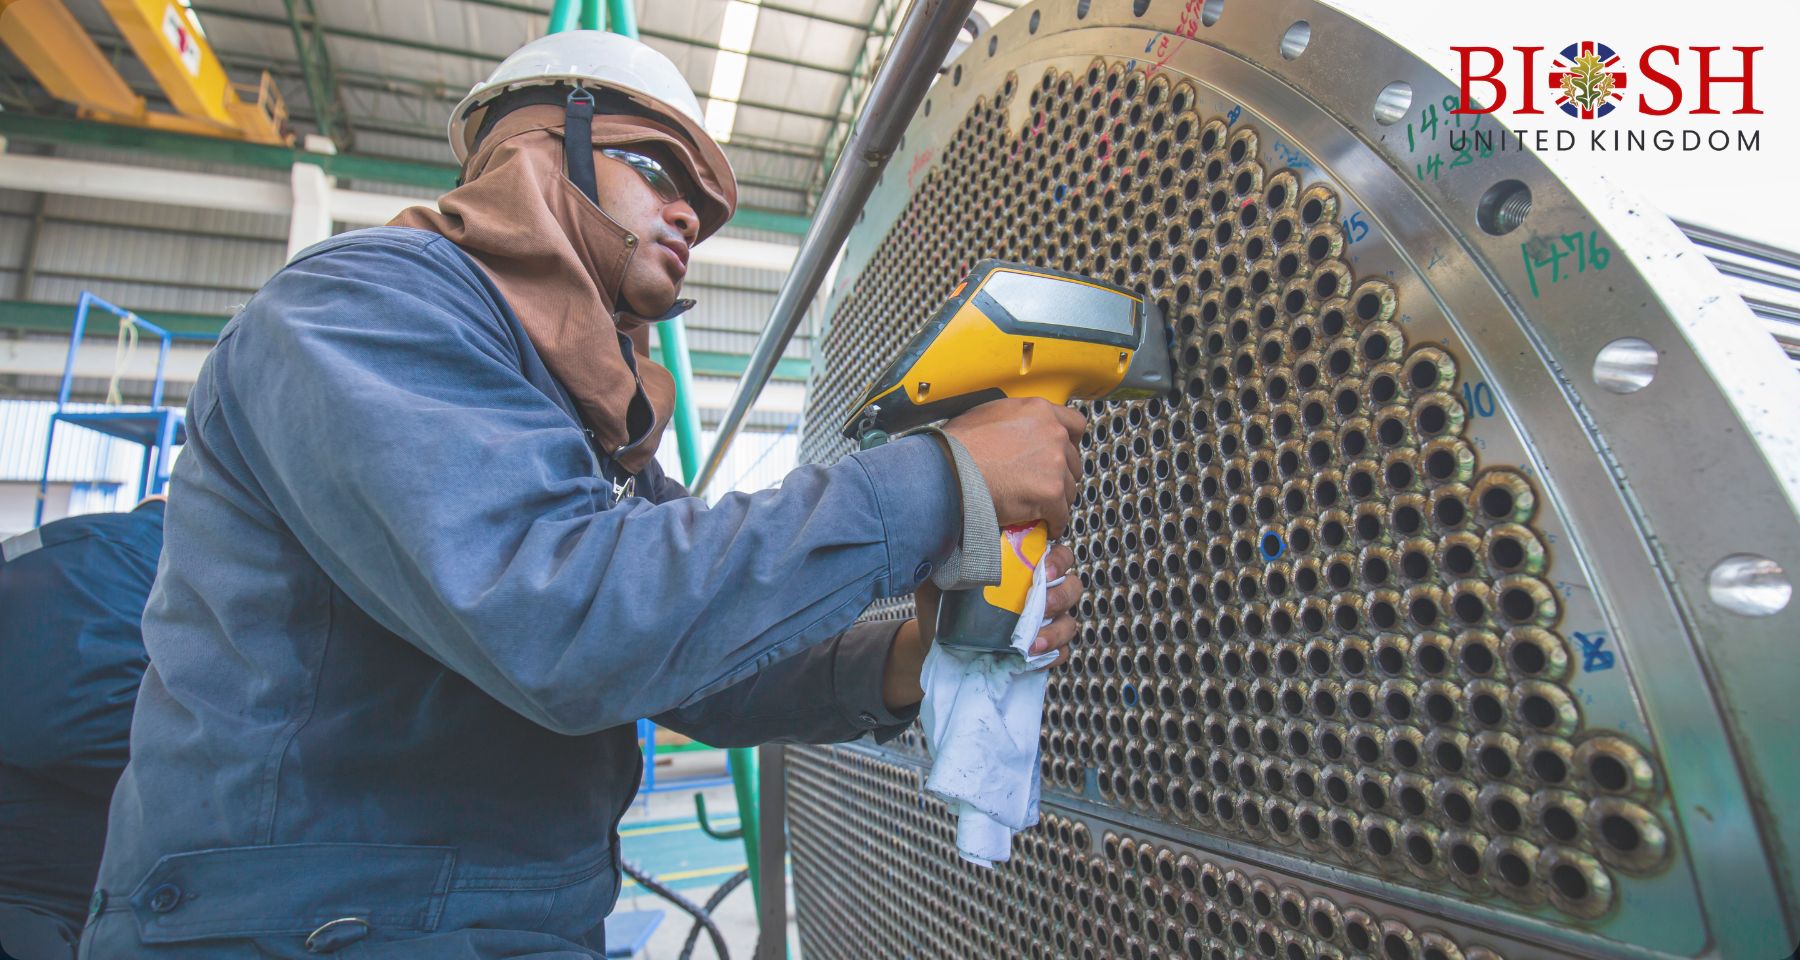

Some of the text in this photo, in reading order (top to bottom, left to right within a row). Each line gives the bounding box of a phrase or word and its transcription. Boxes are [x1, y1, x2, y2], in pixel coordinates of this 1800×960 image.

[1343, 211, 1370, 245] 15
[1521, 230, 1611, 298] 14.76
[1462, 381, 1496, 419] 10
